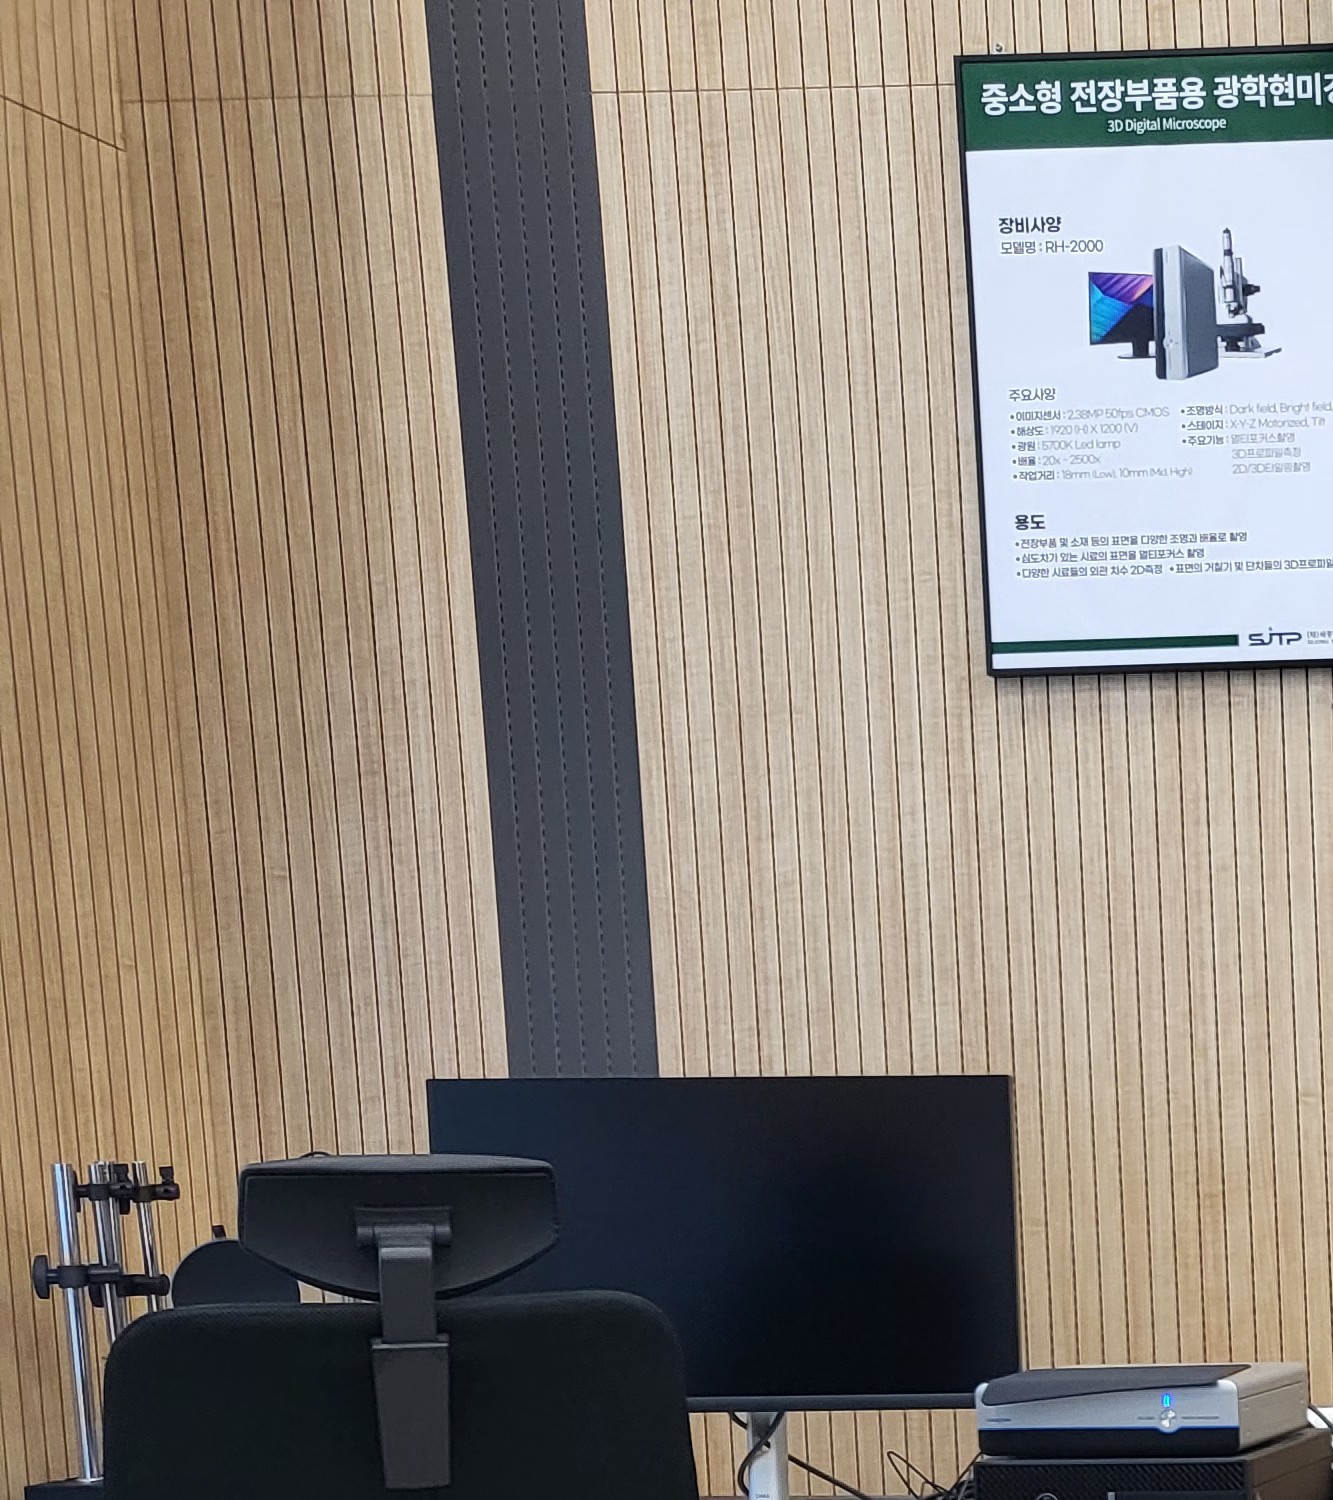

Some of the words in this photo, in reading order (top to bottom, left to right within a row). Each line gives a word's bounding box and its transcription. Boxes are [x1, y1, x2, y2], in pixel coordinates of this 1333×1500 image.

[980, 81, 1062, 116] 중소형
[1070, 76, 1207, 113] 전장부품용
[1107, 119, 1123, 133] 3D
[1125, 117, 1160, 134] Digital
[1163, 116, 1226, 132] Microscope
[998, 216, 1062, 234] 장비사양
[1001, 241, 1037, 255] 모델명
[1045, 240, 1104, 254] RH-2000
[1009, 388, 1055, 401] 주요사양
[1016, 410, 1061, 421] 이미지센서
[1136, 408, 1169, 417] CMOS
[1017, 426, 1044, 436] 해상도
[1018, 442, 1035, 452] 광원
[1096, 439, 1120, 450] lamp
[1188, 435, 1224, 445] 주요기능
[1019, 471, 1055, 480] 작업거리
[1015, 515, 1045, 530] 용도
[1021, 538, 1057, 549] 전장부품
[1070, 537, 1088, 547] 소재
[1141, 534, 1167, 545] 다양한
[1022, 569, 1049, 578] 다양한
[1110, 566, 1128, 575] 치수
